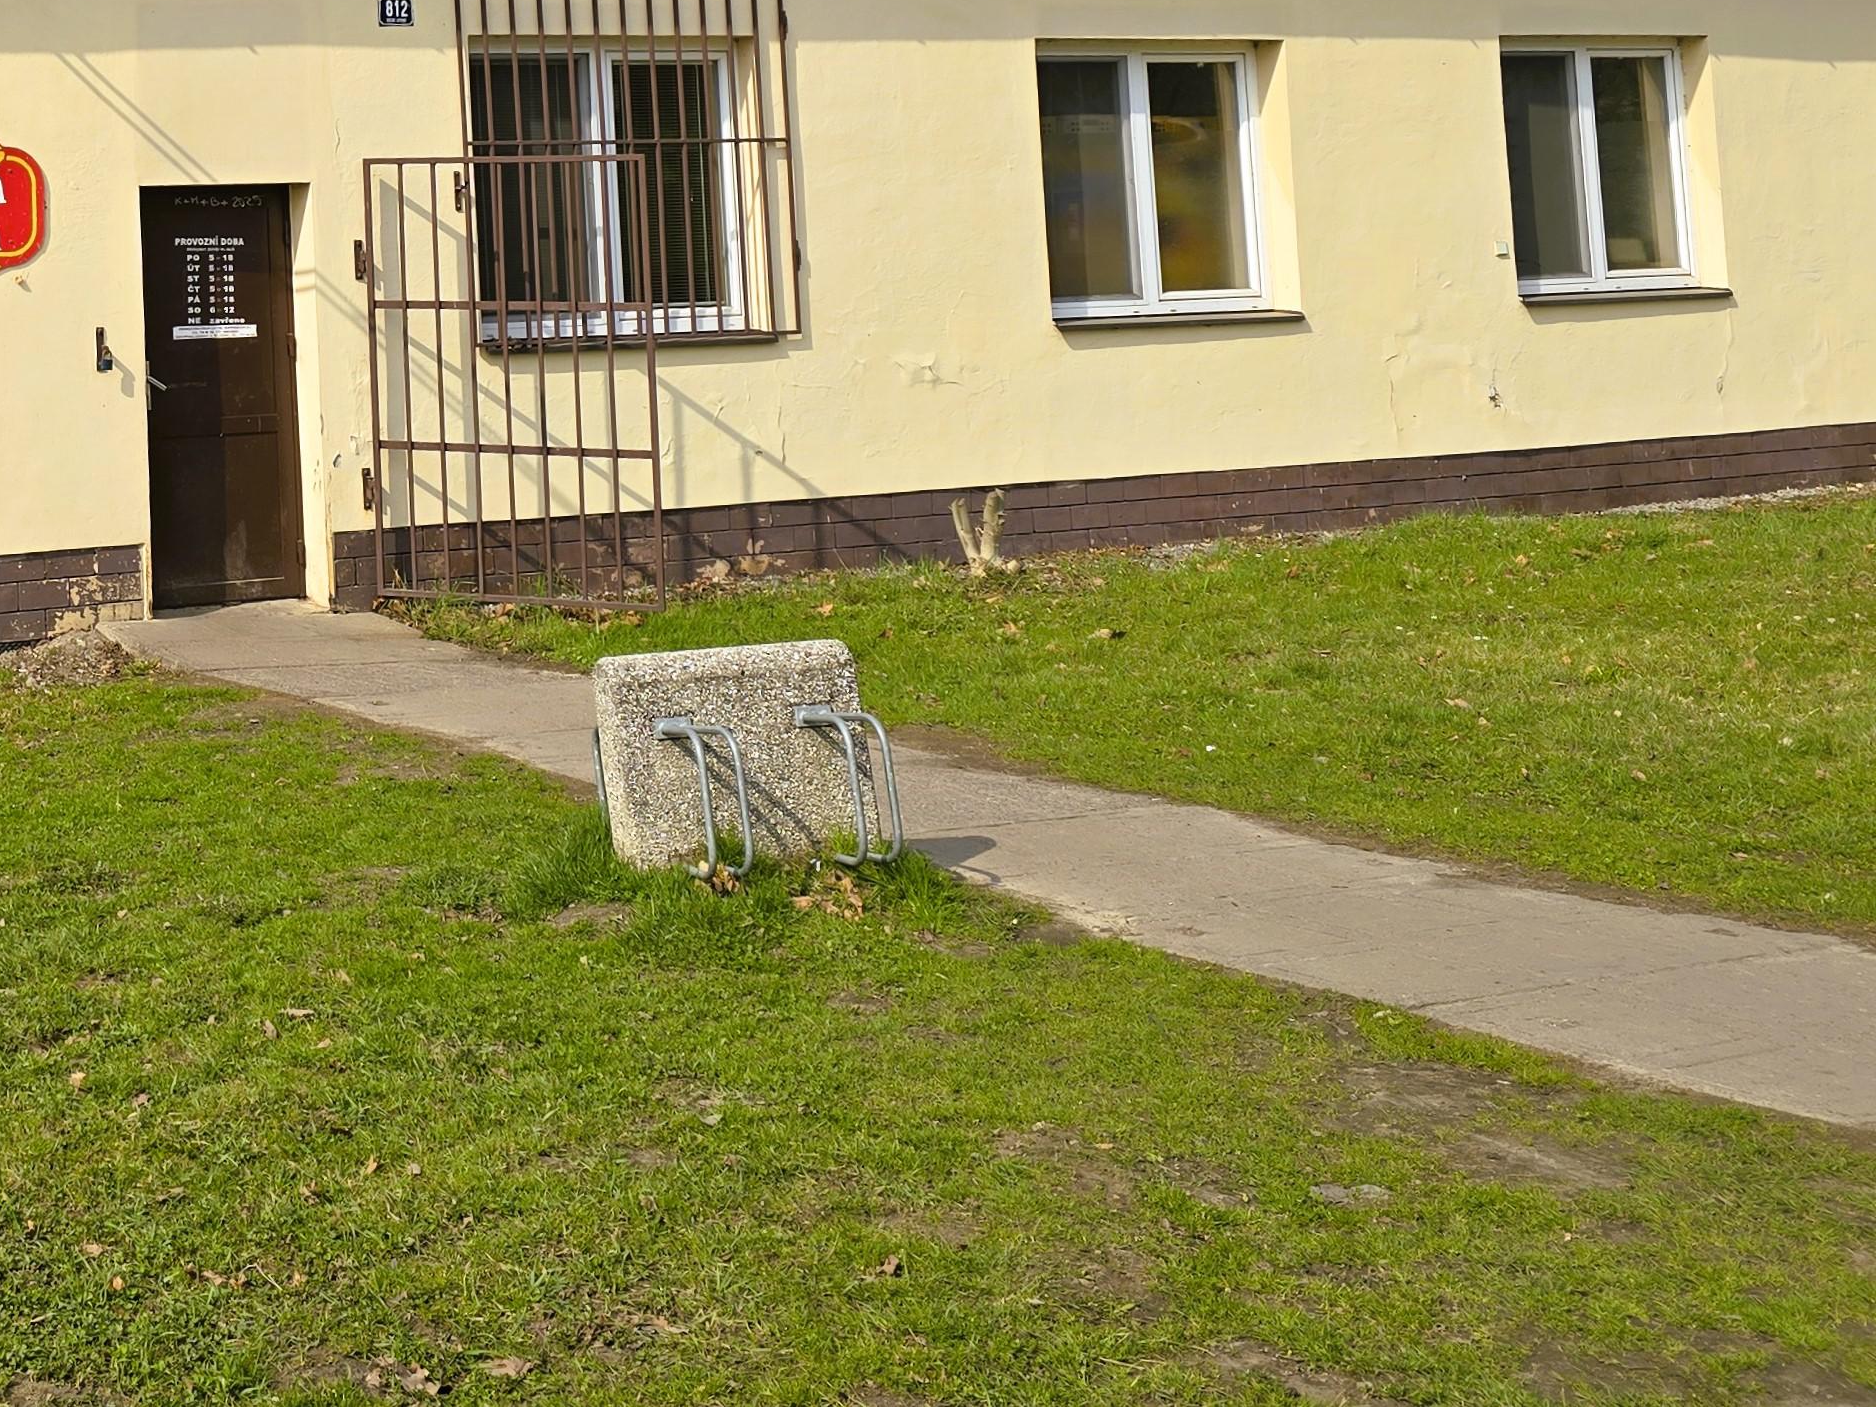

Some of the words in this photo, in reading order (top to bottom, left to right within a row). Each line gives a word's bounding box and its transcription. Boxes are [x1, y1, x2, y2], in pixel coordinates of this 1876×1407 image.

[386, 0, 408, 17] 812
[175, 235, 219, 246] PROVOZNÍ
[220, 238, 244, 246] DOBA
[187, 254, 200, 262] PO
[187, 263, 200, 272] ÚT
[187, 275, 200, 283] ST
[188, 284, 200, 293] ČT
[188, 294, 201, 303] PÁ
